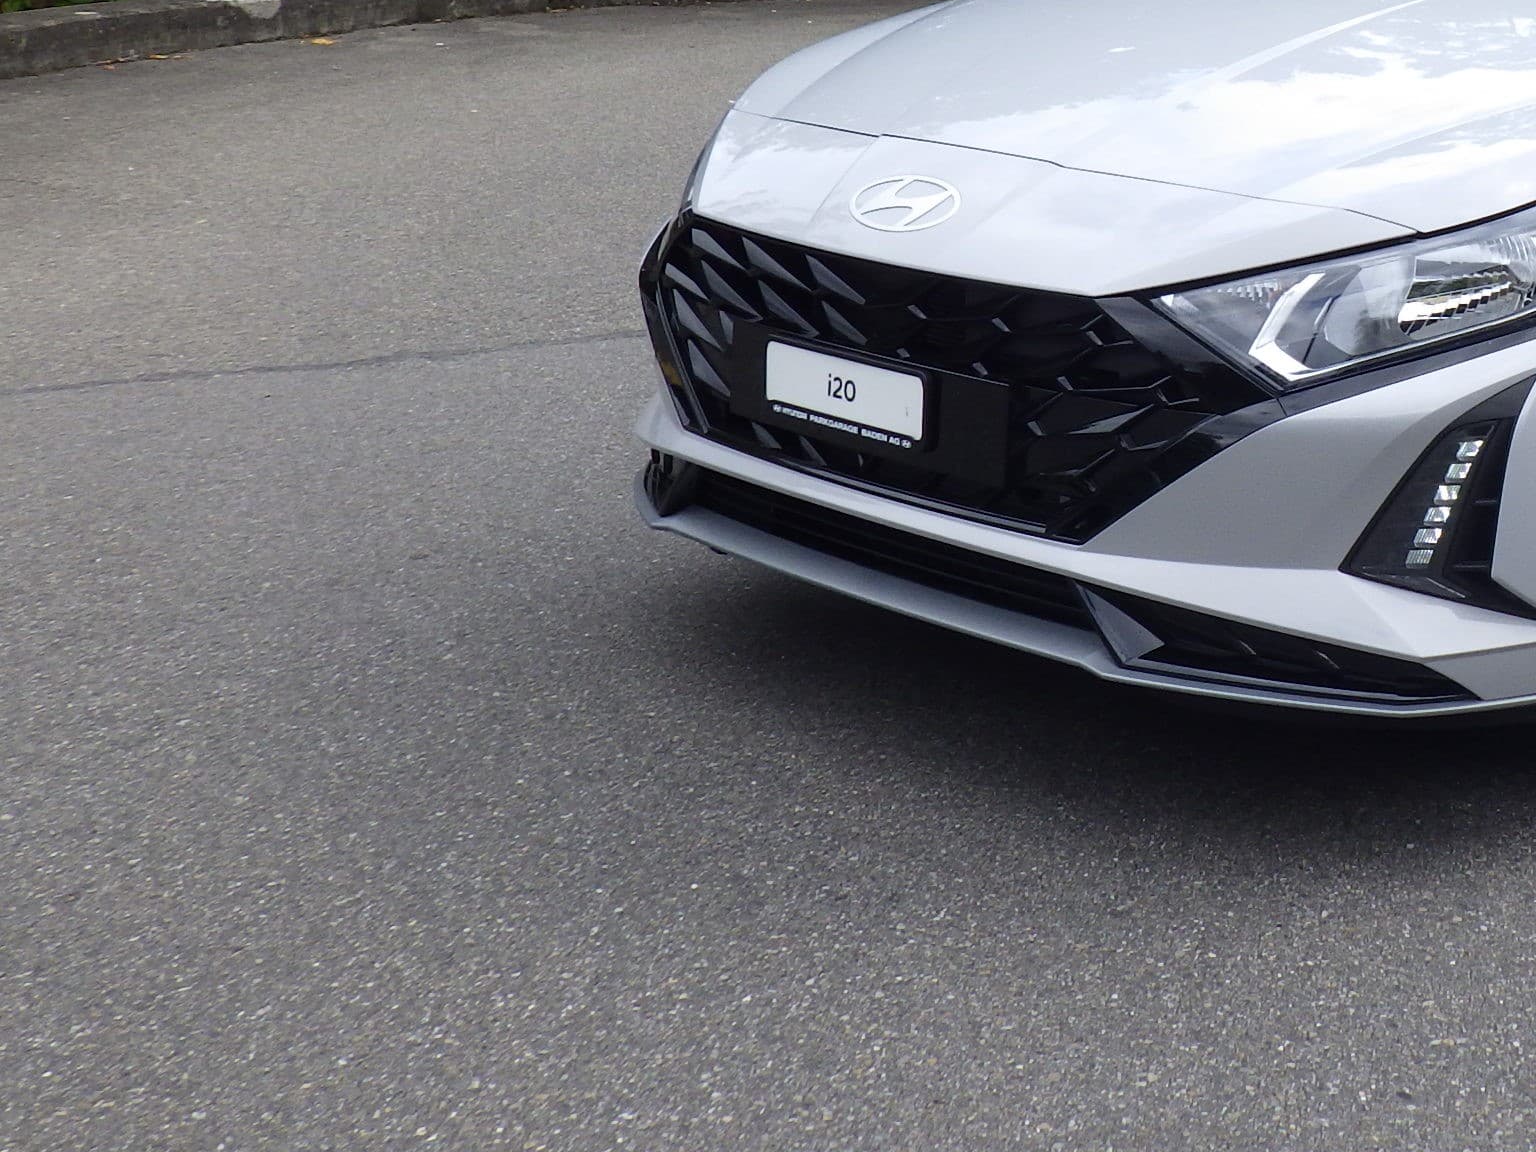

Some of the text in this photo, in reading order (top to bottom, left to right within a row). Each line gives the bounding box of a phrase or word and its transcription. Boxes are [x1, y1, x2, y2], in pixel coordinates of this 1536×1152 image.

[827, 373, 857, 402] i20
[809, 414, 858, 434] PARKGARAGE
[861, 428, 888, 441] BADEN
[889, 436, 901, 446] AG
